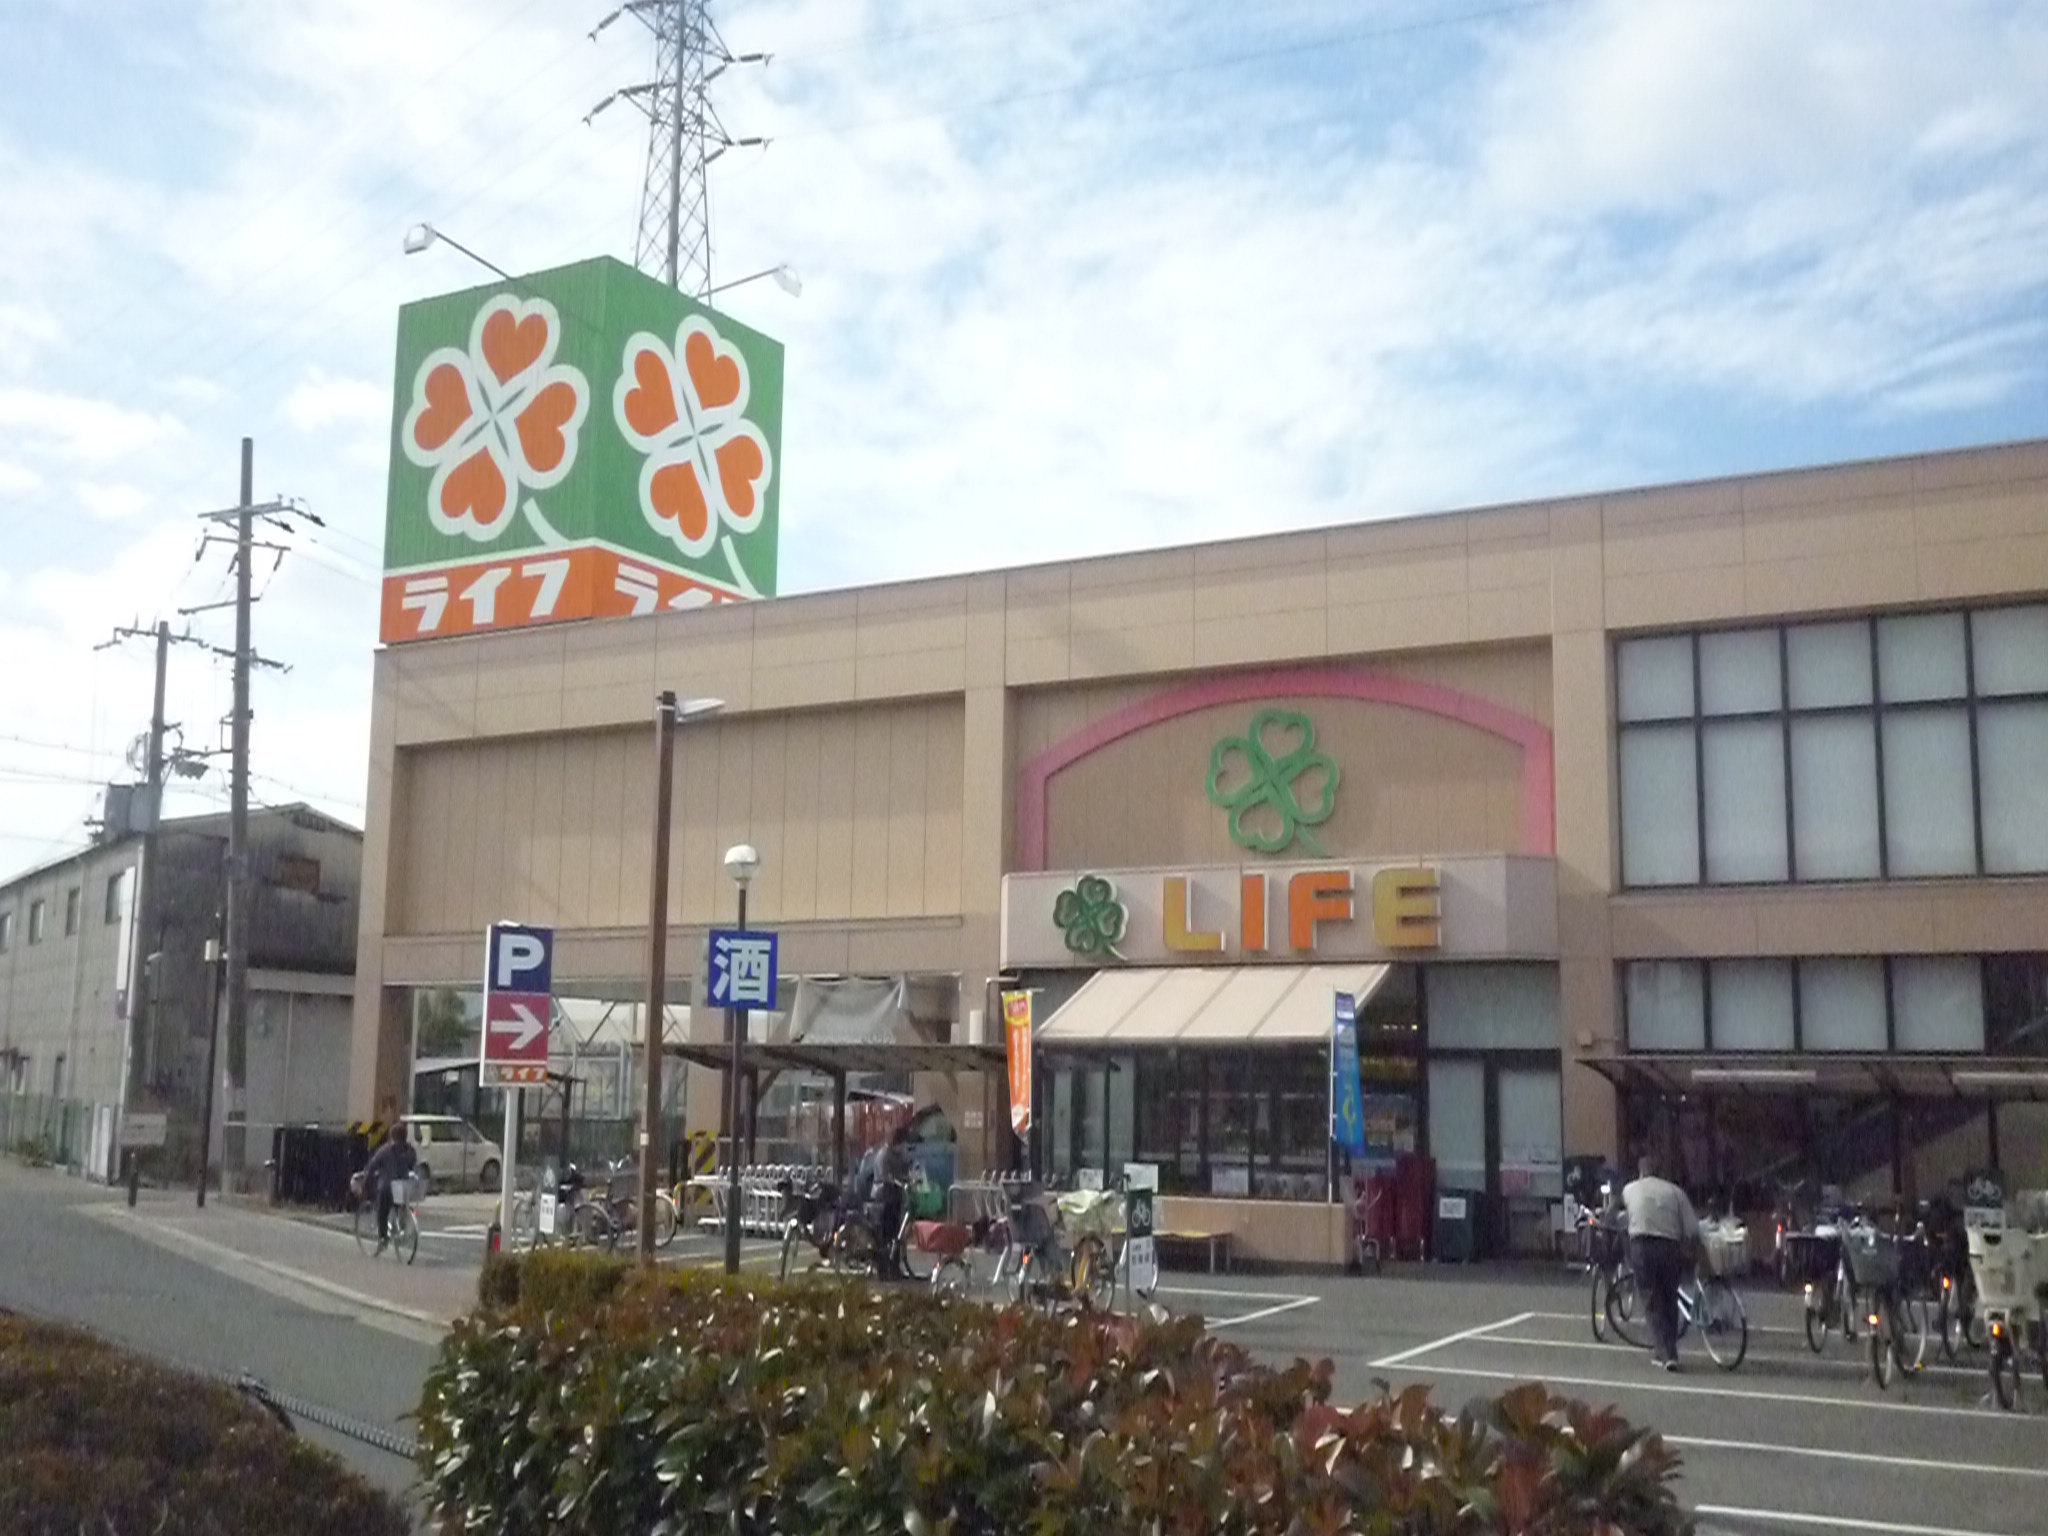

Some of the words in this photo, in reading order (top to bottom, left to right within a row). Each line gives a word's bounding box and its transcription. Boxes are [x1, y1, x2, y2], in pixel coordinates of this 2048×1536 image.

[402, 558, 571, 632] ライフ
[1163, 868, 1442, 952] LIFE
[498, 933, 545, 986] P
[713, 936, 771, 1002] 酒
